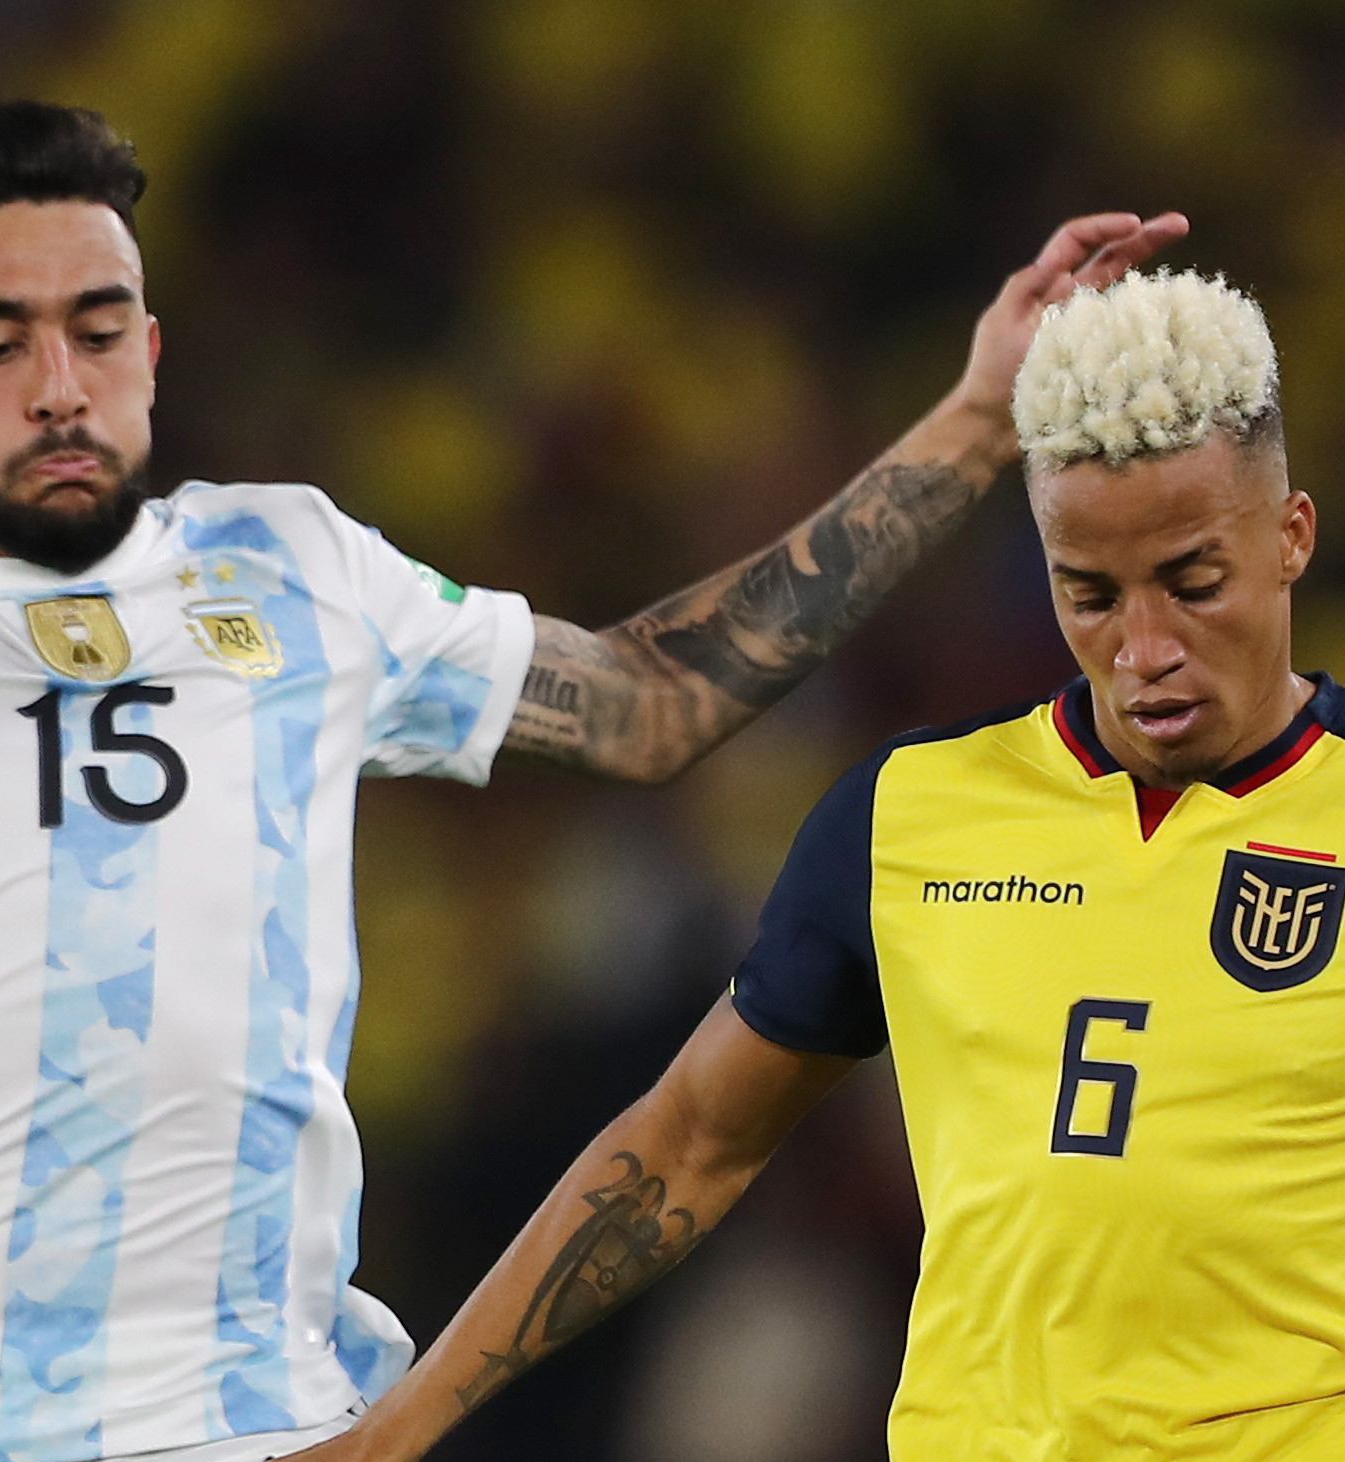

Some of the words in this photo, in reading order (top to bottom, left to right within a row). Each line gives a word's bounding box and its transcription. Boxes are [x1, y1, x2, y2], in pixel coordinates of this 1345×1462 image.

[17, 681, 189, 829] 15
[922, 874, 1084, 906] marathon
[1049, 996, 1153, 1158] 6
